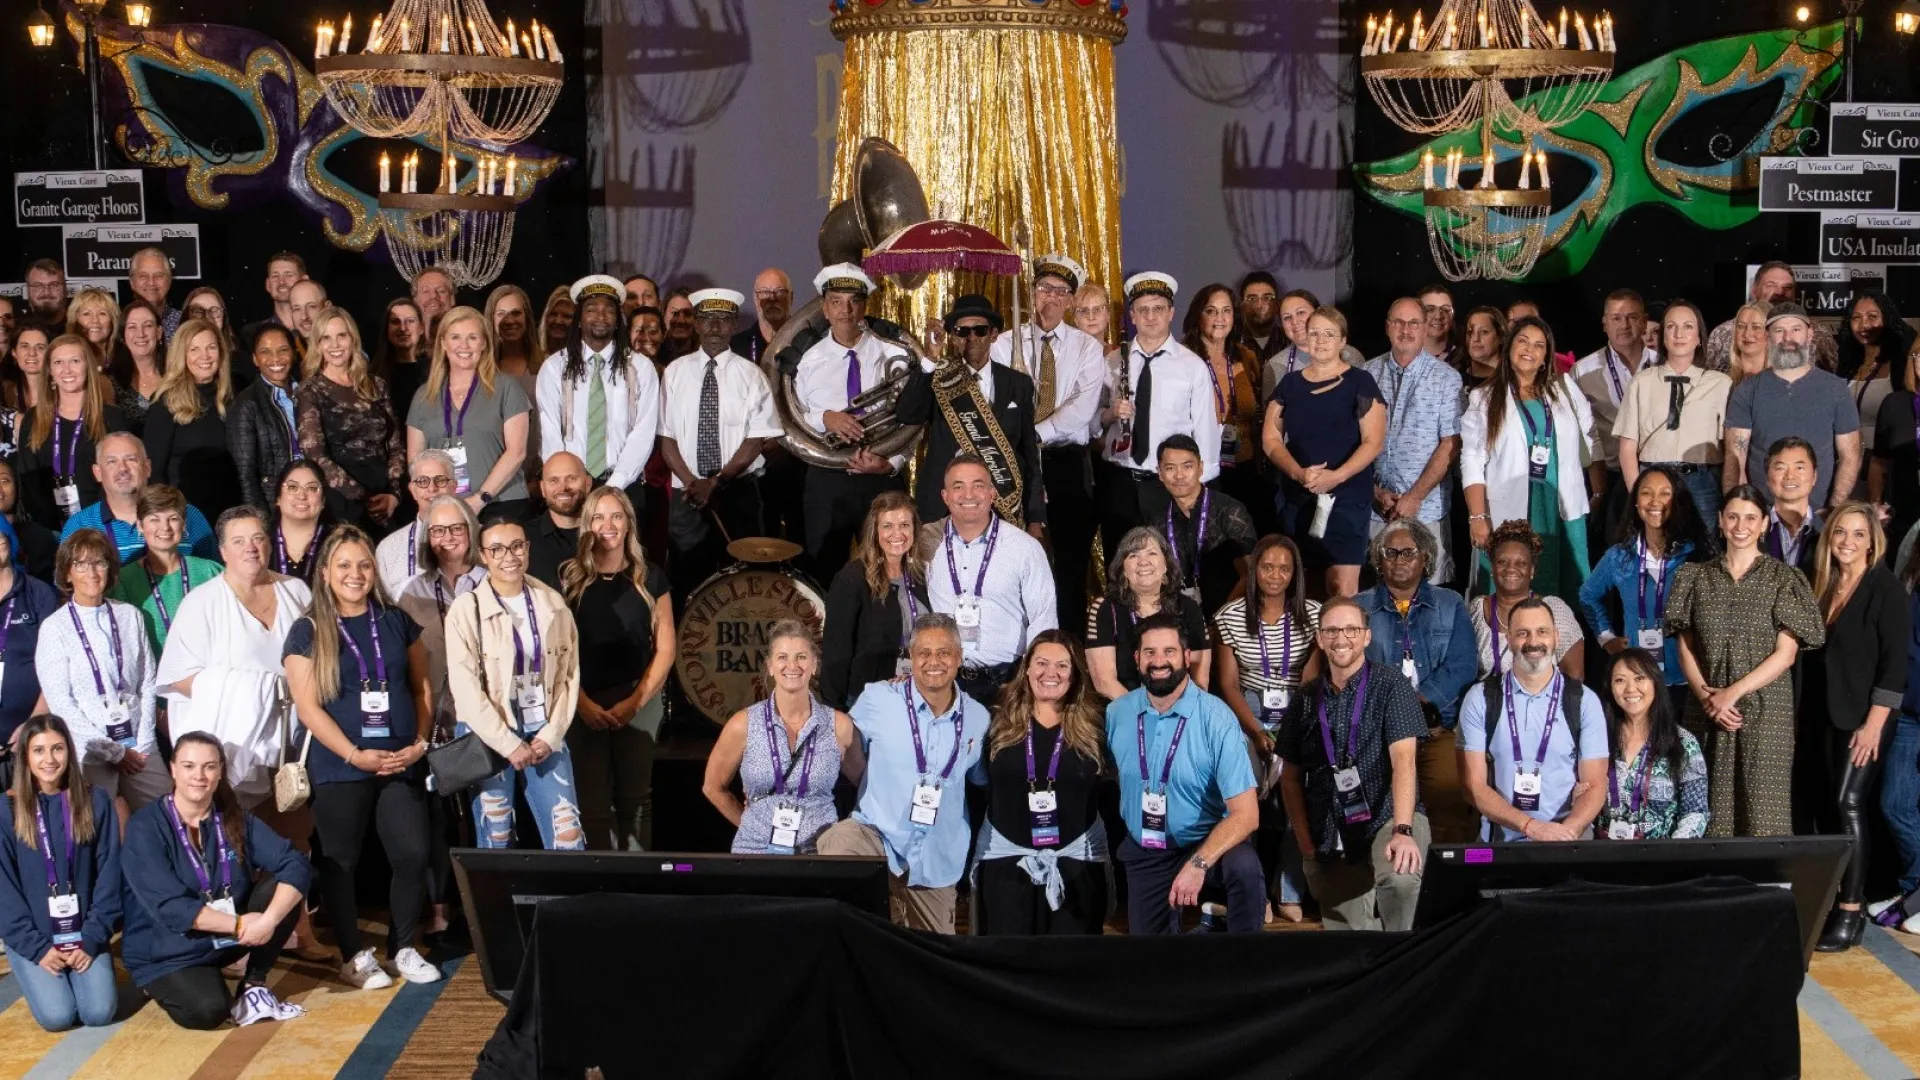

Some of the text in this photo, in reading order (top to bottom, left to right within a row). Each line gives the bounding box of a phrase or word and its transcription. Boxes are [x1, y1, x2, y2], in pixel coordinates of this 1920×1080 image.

[1877, 108, 1901, 118] Vieux
[1861, 128, 1920, 149] Sir Gro
[1808, 162, 1832, 171] Vieux
[54, 176, 77, 186] Vieux
[1787, 182, 1873, 202] Pestmaster
[20, 195, 139, 222] Granite Garage Floors
[1867, 216, 1890, 226] Vieux
[106, 230, 132, 240] Vieux
[1828, 236, 1866, 256] USA
[1795, 270, 1819, 280] Vieux
[958, 410, 1012, 485] Grand Marshal
